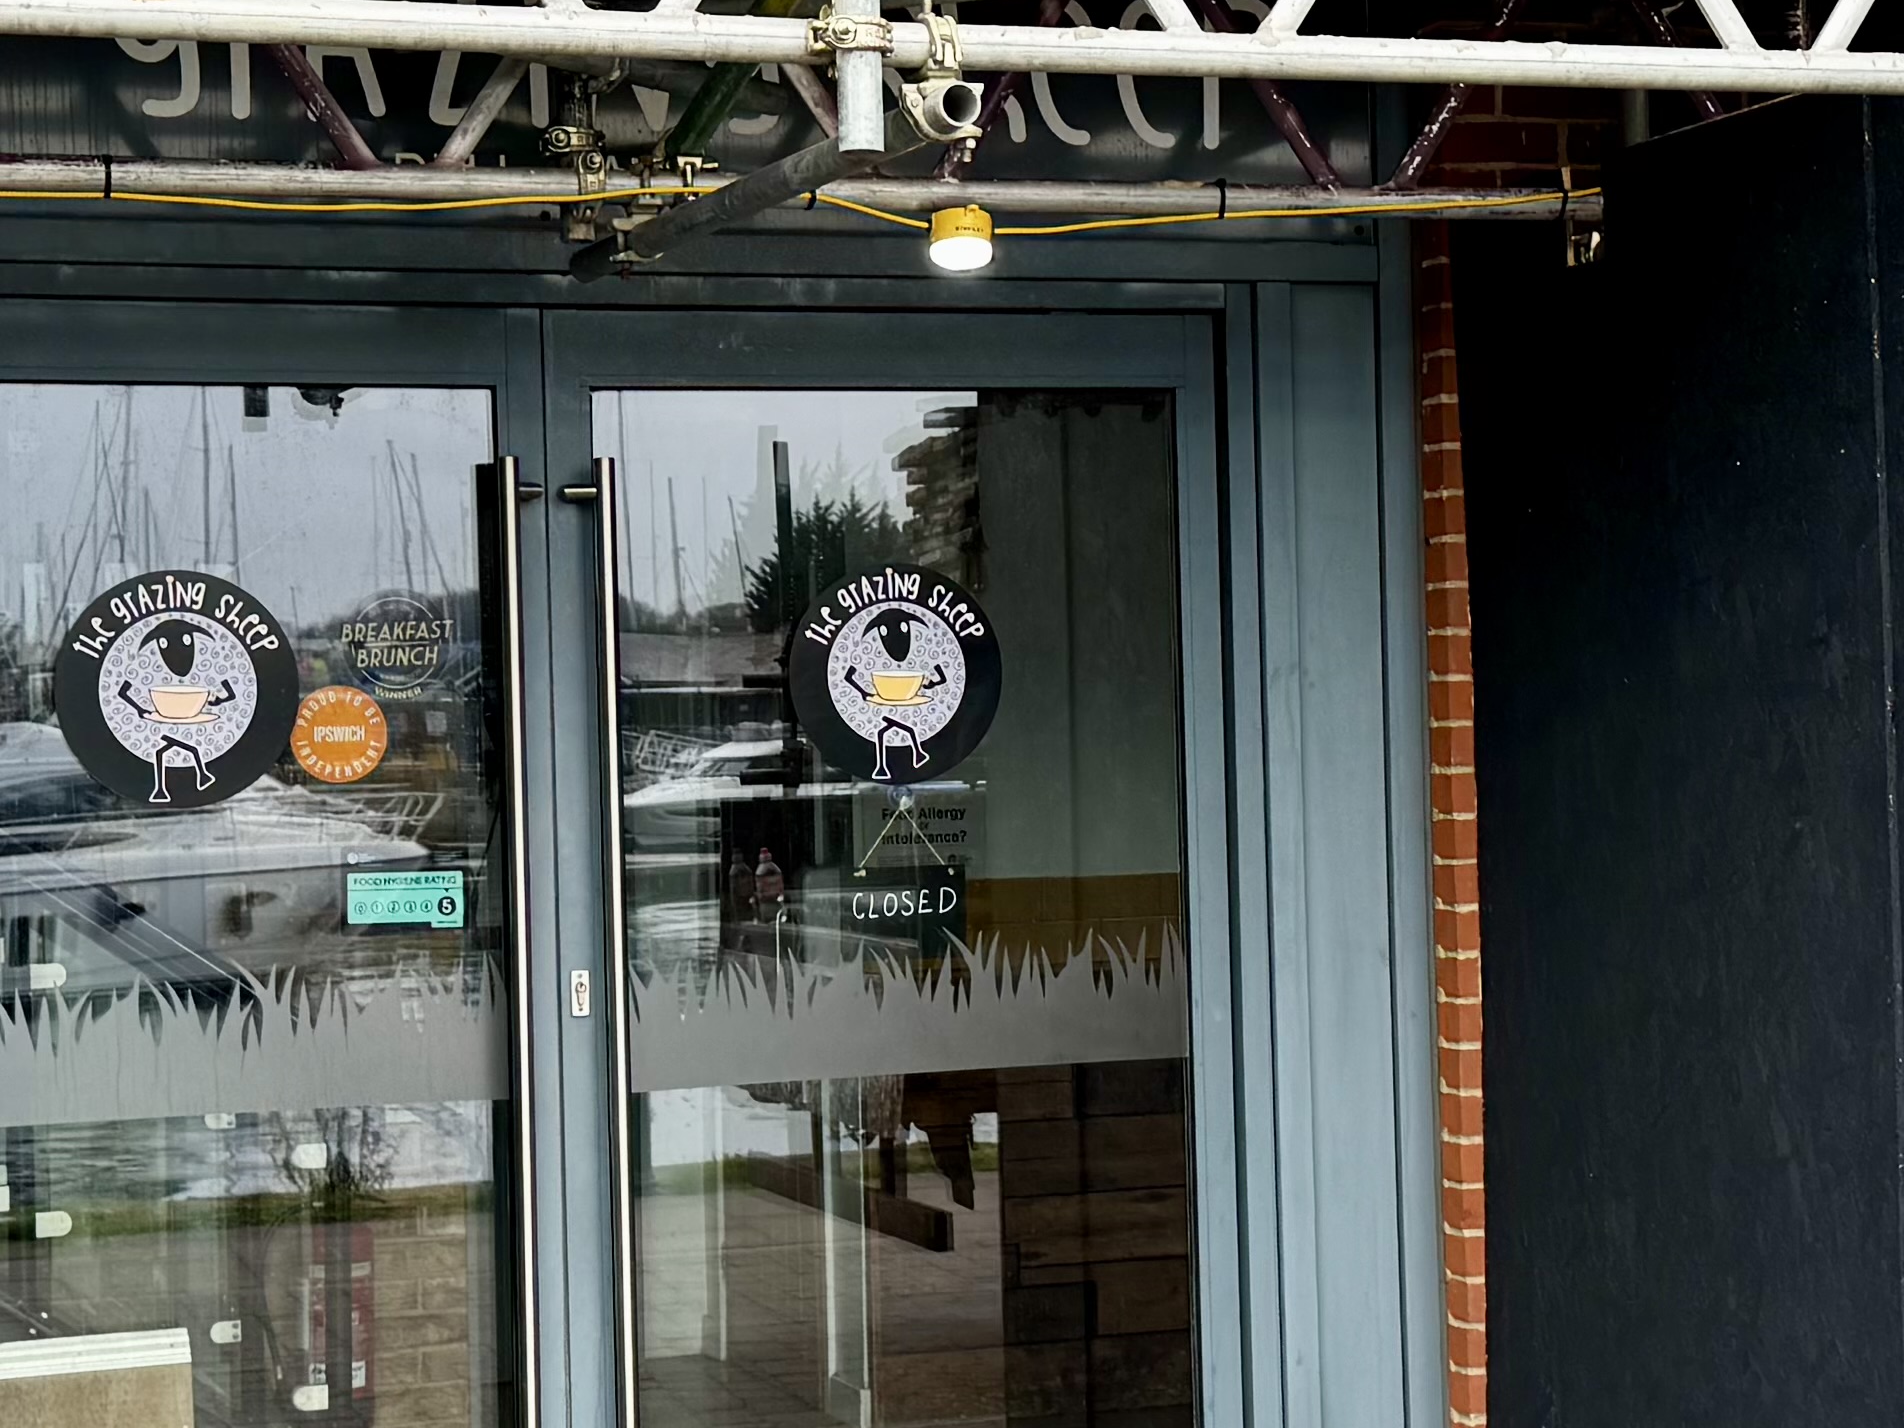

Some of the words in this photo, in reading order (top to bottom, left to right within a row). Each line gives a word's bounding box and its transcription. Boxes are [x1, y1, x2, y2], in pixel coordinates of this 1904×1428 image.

[72, 616, 116, 658] the
[341, 619, 454, 643] BREAKFAST
[804, 606, 843, 646] the
[357, 645, 438, 668] BRUNCH
[297, 691, 336, 728] PROUD
[346, 691, 363, 707] TO
[364, 707, 381, 725] BE
[313, 725, 365, 743] IPSWICH
[297, 740, 382, 779] INDEPENDENT
[918, 807, 966, 821] Allergy
[441, 898, 453, 914] 5
[852, 886, 957, 920] CLOSED
